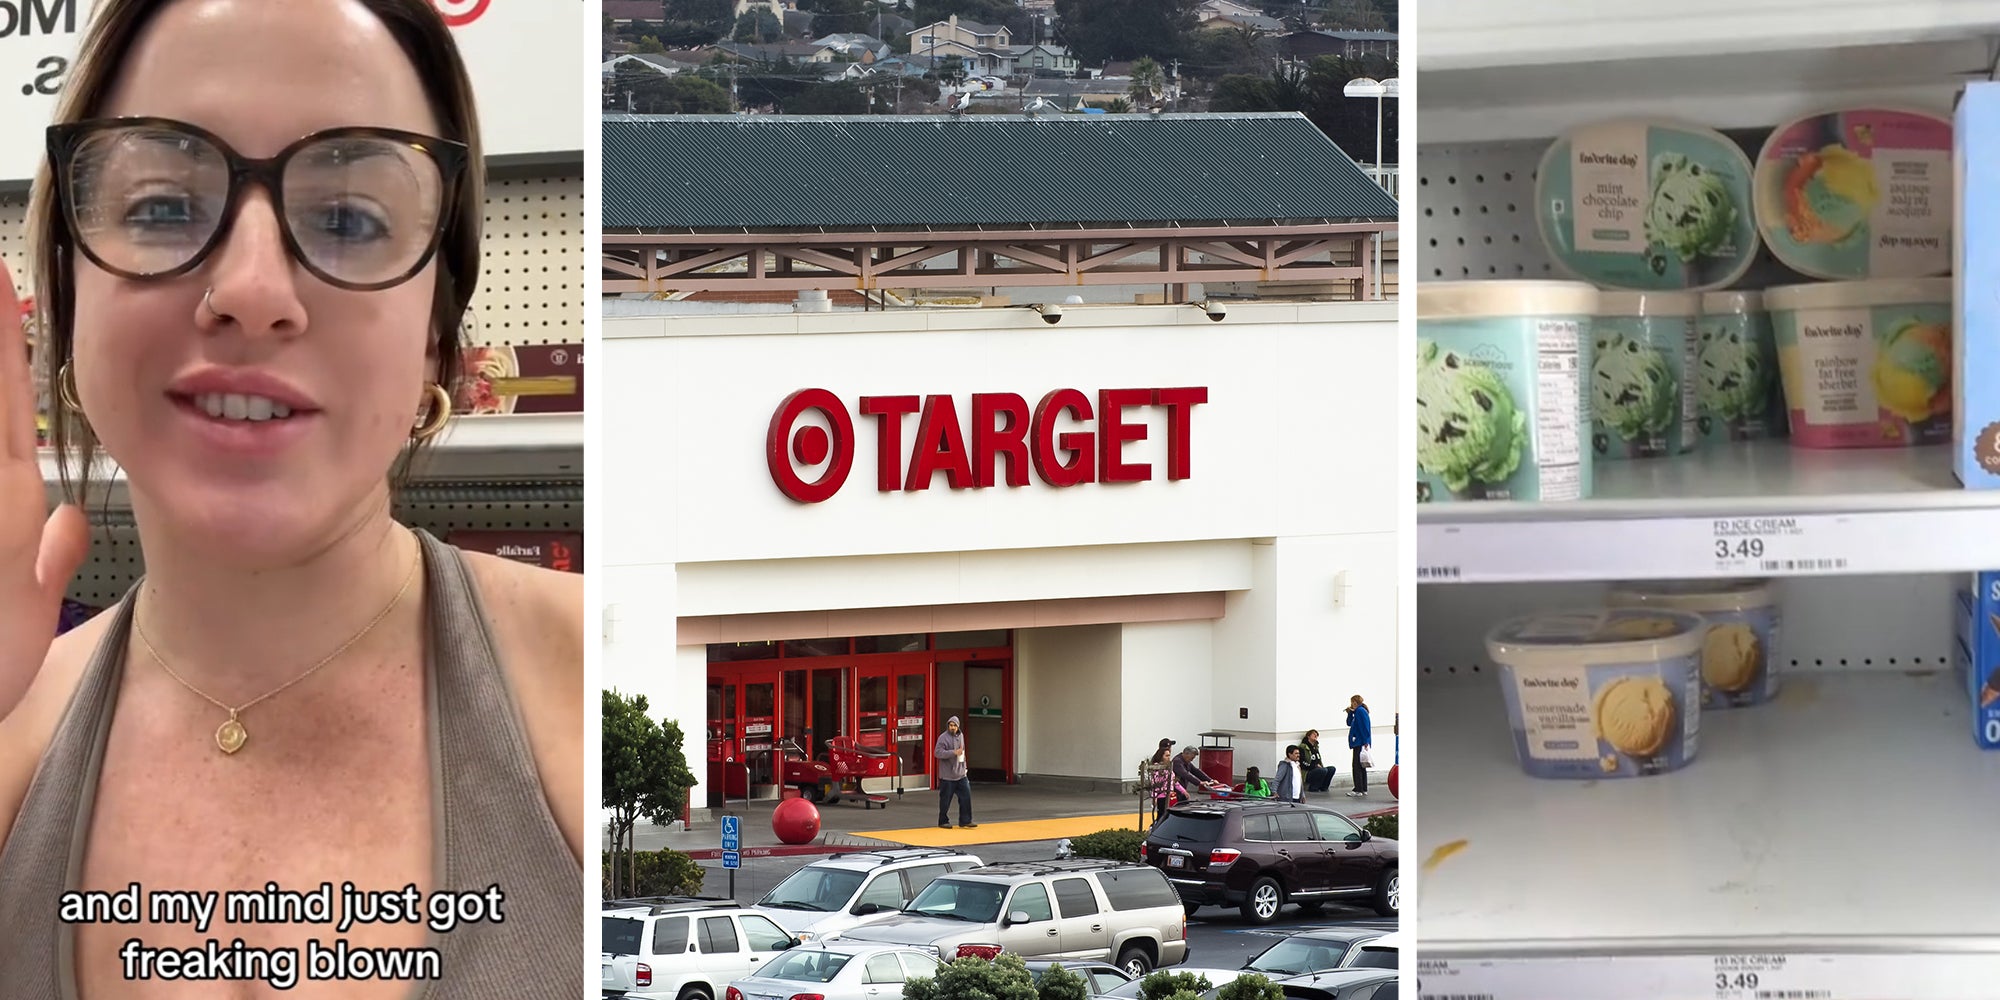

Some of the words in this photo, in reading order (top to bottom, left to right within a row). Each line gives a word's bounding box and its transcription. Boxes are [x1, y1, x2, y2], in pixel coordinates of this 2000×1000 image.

[1579, 152, 1618, 165] favorite
[1619, 153, 1638, 169] day
[1596, 183, 1624, 194] mint
[1582, 194, 1639, 207] chocolate
[1598, 206, 1624, 221] chip
[1814, 355, 1859, 368] rainbow
[1818, 368, 1833, 380] fat
[1834, 367, 1856, 379] free
[1818, 379, 1858, 392] sherbet
[859, 386, 1208, 492] TARGET
[1713, 520, 1729, 531] FD
[1732, 519, 1750, 530] ICE
[1754, 518, 1796, 528] CREAM
[1715, 537, 1765, 559] 3.49
[1523, 678, 1560, 688] favorite
[1560, 677, 1580, 690] day
[1526, 703, 1586, 714] homemade
[1538, 713, 1576, 723] vanilla
[1749, 956, 1787, 964] CREAM
[1715, 972, 1759, 990] 3.49
